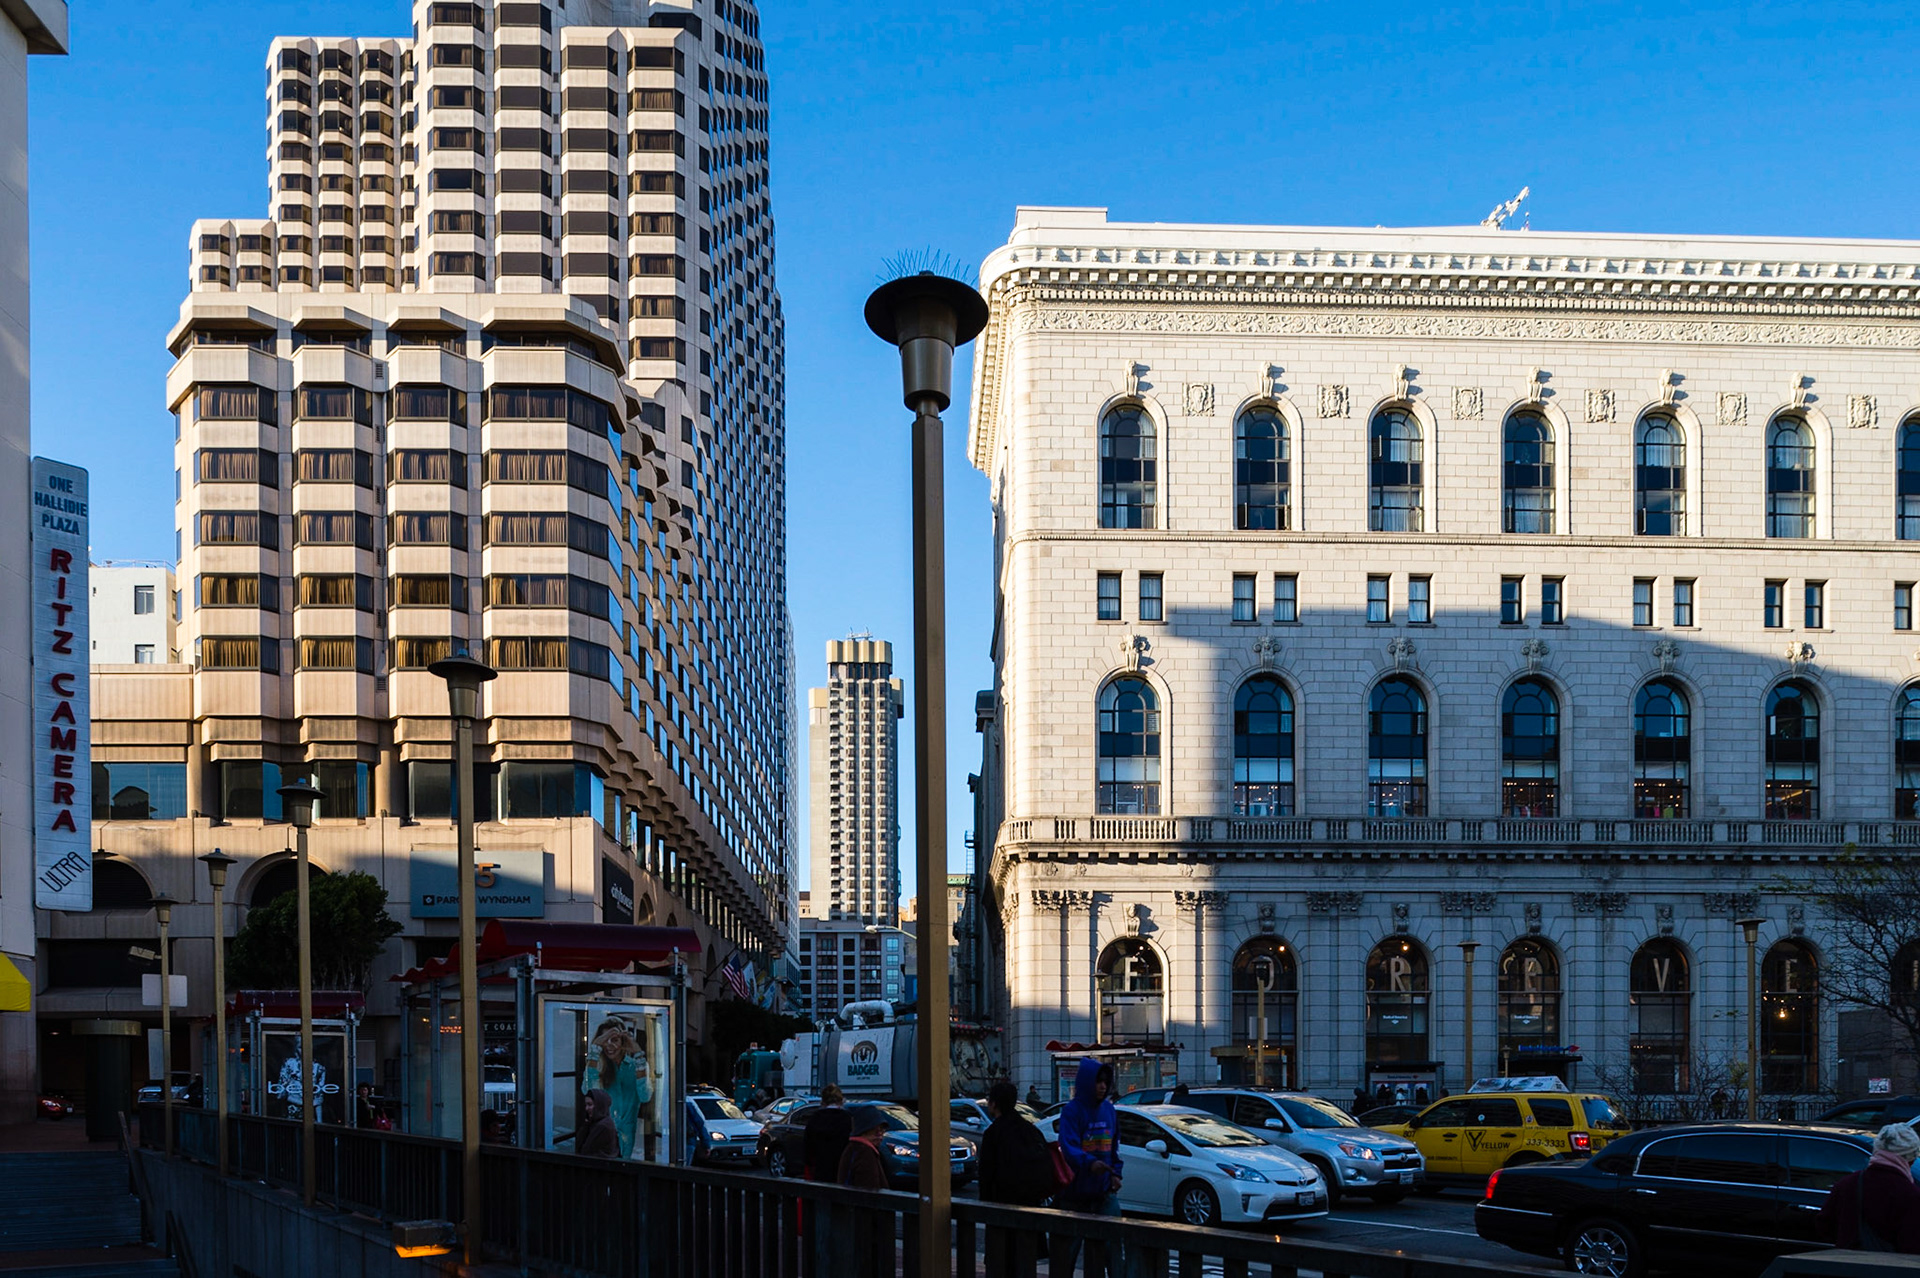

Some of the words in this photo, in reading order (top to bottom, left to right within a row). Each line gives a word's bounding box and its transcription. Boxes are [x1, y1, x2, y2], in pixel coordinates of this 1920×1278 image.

[49, 475, 73, 494] ONE
[34, 491, 87, 517] HALLIDIE
[42, 513, 80, 535] PLAZA
[50, 548, 73, 655] RITZ
[51, 672, 77, 833] CAMERA
[39, 851, 91, 893] ULTRA
[478, 896, 531, 904] WYNDHAM
[847, 1064, 880, 1077] BADGER
[1402, 1131, 1417, 1139] 807
[1526, 1138, 1566, 1149] 333-3333
[1480, 1142, 1511, 1150] YELLOW
